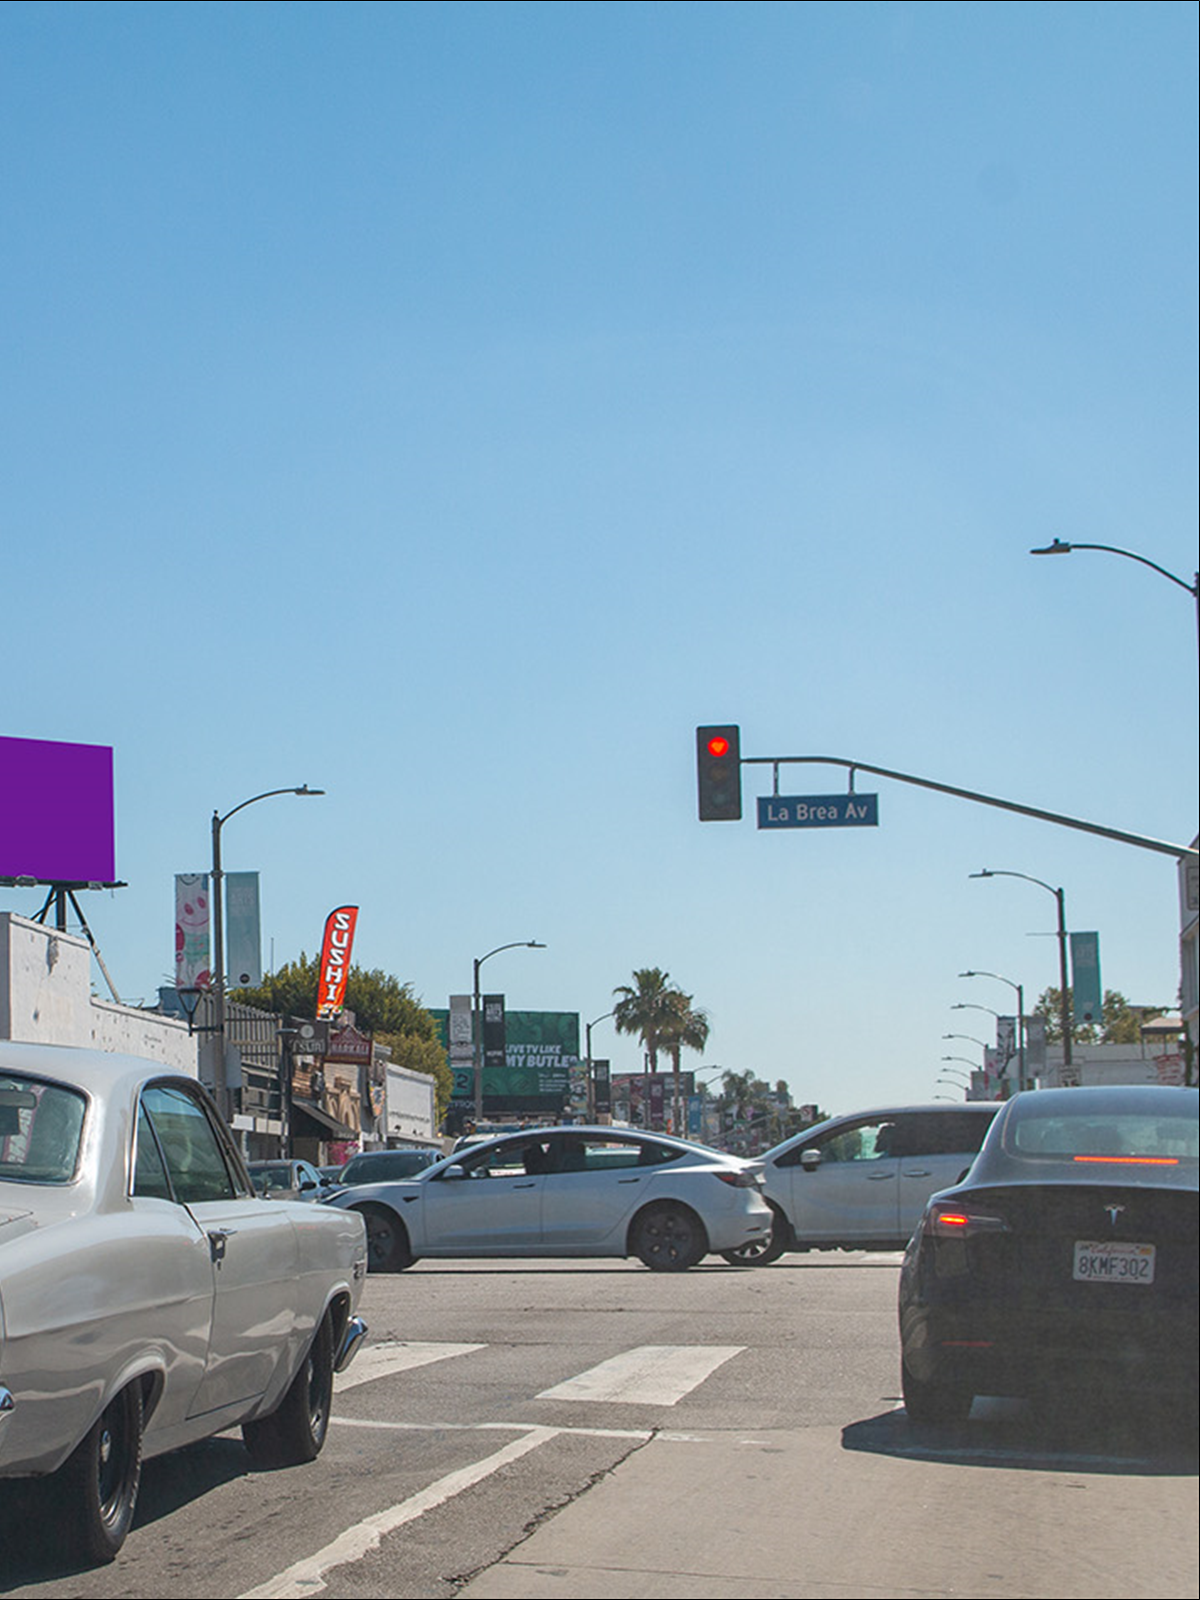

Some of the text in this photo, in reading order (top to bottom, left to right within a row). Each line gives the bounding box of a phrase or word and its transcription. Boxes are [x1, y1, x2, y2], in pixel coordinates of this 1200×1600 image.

[768, 802, 868, 821] La Brea Av
[325, 912, 351, 1001] SUSHI
[526, 1044, 539, 1054] TV
[539, 1044, 562, 1055] LIKE
[1079, 1256, 1149, 1278] 8KMF302
